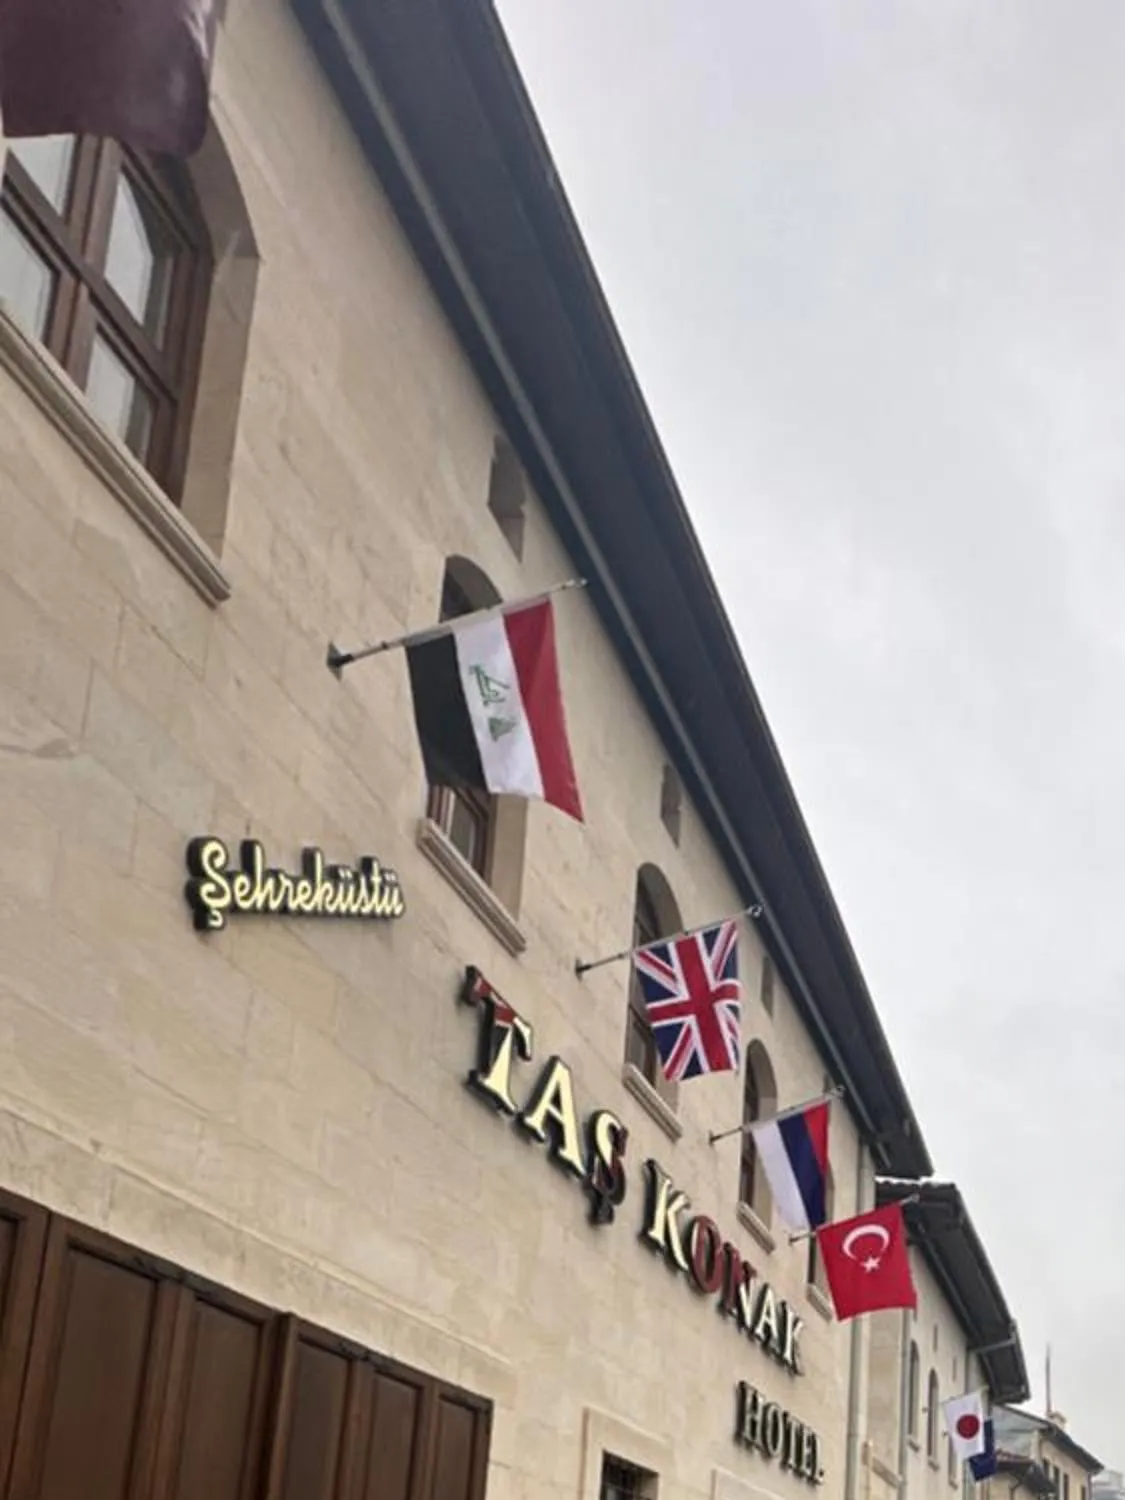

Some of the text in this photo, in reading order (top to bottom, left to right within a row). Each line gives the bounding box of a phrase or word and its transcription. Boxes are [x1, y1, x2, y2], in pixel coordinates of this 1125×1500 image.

[189, 837, 405, 929] Şehreküstü
[460, 964, 804, 1375] TAŞ KONAK
[735, 1380, 824, 1486] HOTEL
